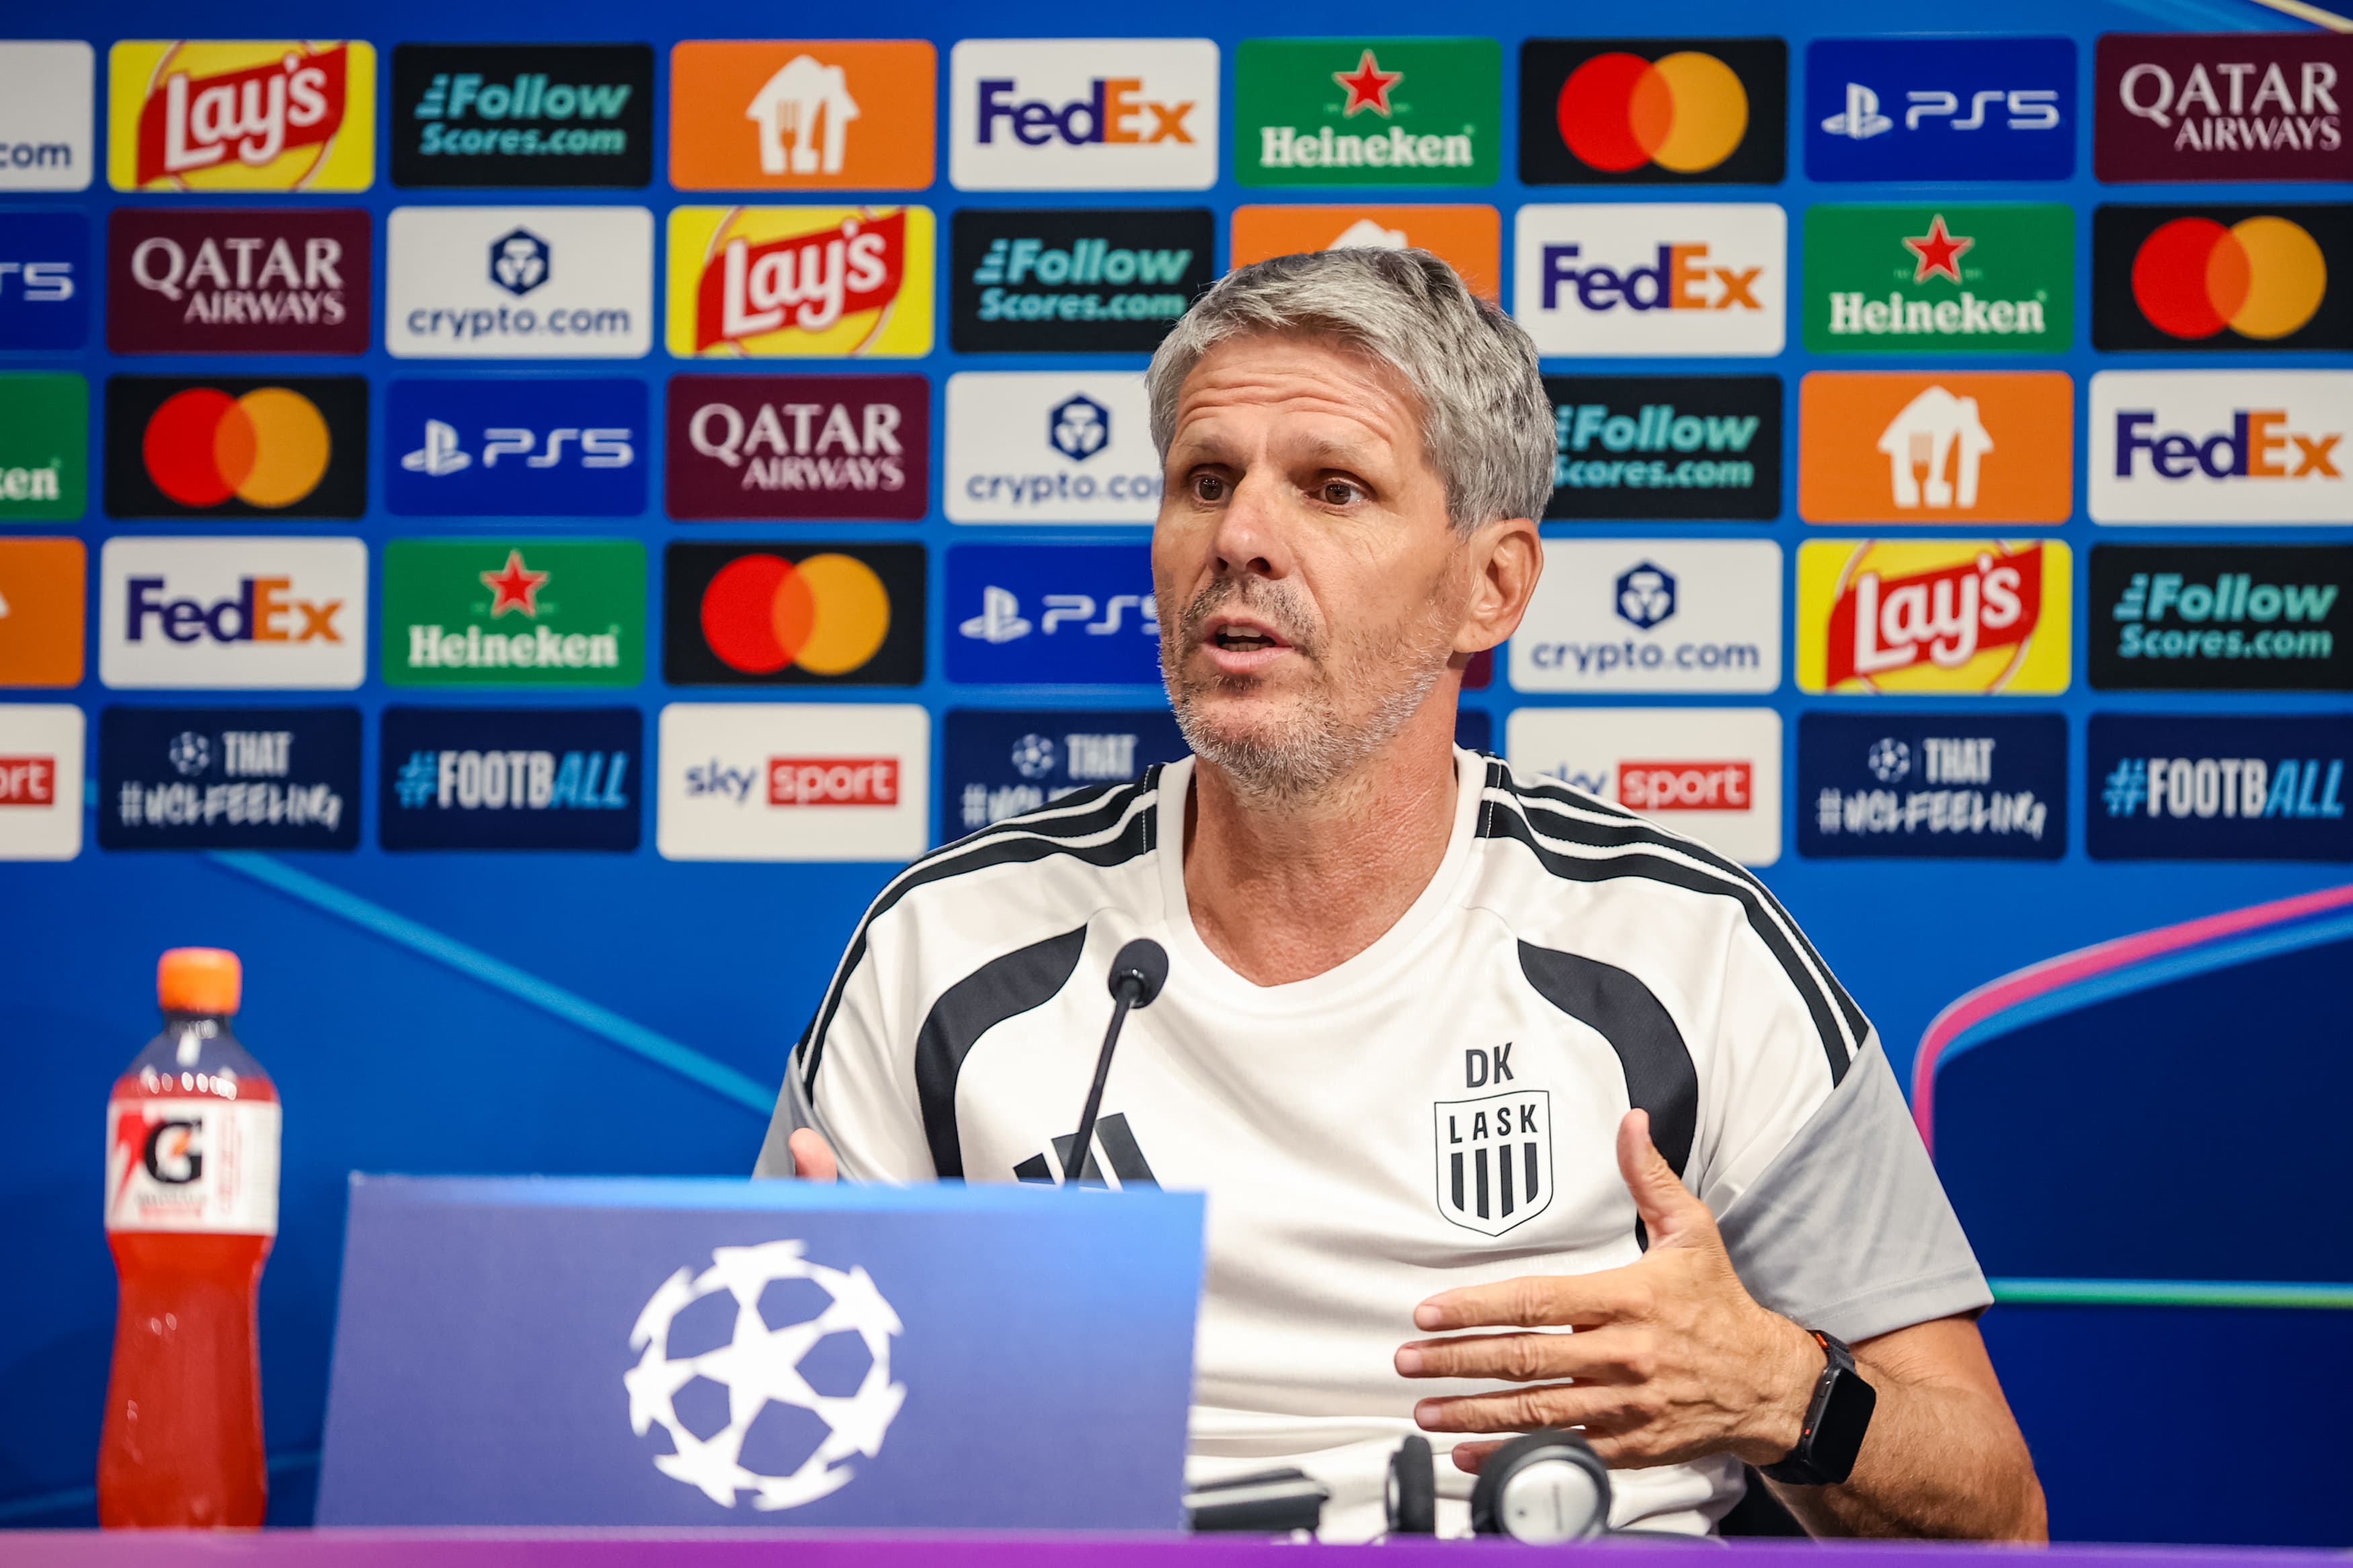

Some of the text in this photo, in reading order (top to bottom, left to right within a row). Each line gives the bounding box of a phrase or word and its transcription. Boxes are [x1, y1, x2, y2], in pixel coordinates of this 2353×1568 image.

[165, 54, 327, 171] Lay's
[977, 78, 1195, 146] FedEx
[1905, 91, 2060, 130] PS5
[2120, 63, 2338, 128] QATAR
[421, 122, 626, 155] Scores.com
[1260, 126, 1474, 167] Heineken
[2176, 117, 2341, 151] AIRWAYS
[132, 237, 343, 300] QATAR
[722, 220, 886, 337] Lay's
[1542, 243, 1763, 311] FedEx
[185, 291, 345, 325] AIRWAYS
[406, 306, 631, 340] crypto.com
[978, 287, 1187, 321] Scores.com
[1829, 292, 2046, 334] Heineken
[483, 428, 634, 468] PS5
[689, 403, 903, 465] QATAR
[2115, 410, 2342, 479] FedEx
[742, 457, 905, 489] AIRWAYS
[124, 576, 343, 645] FedEx
[1854, 554, 2022, 673] Lay's
[407, 625, 619, 667] Heineken
[1530, 640, 1760, 674] crypto.com
[2118, 624, 2333, 658] Scores.com
[223, 731, 292, 776] THAT
[1066, 734, 1138, 779] THAT
[1923, 738, 1995, 784] THAT
[395, 751, 629, 809] #FOOTBALL
[685, 759, 895, 806] sky sport
[1622, 766, 1746, 809] sport
[2103, 759, 2344, 818] #FOOTBALL
[1466, 1042, 1514, 1088] DK
[1449, 1104, 1538, 1144] LASK
[145, 1118, 203, 1185] G
